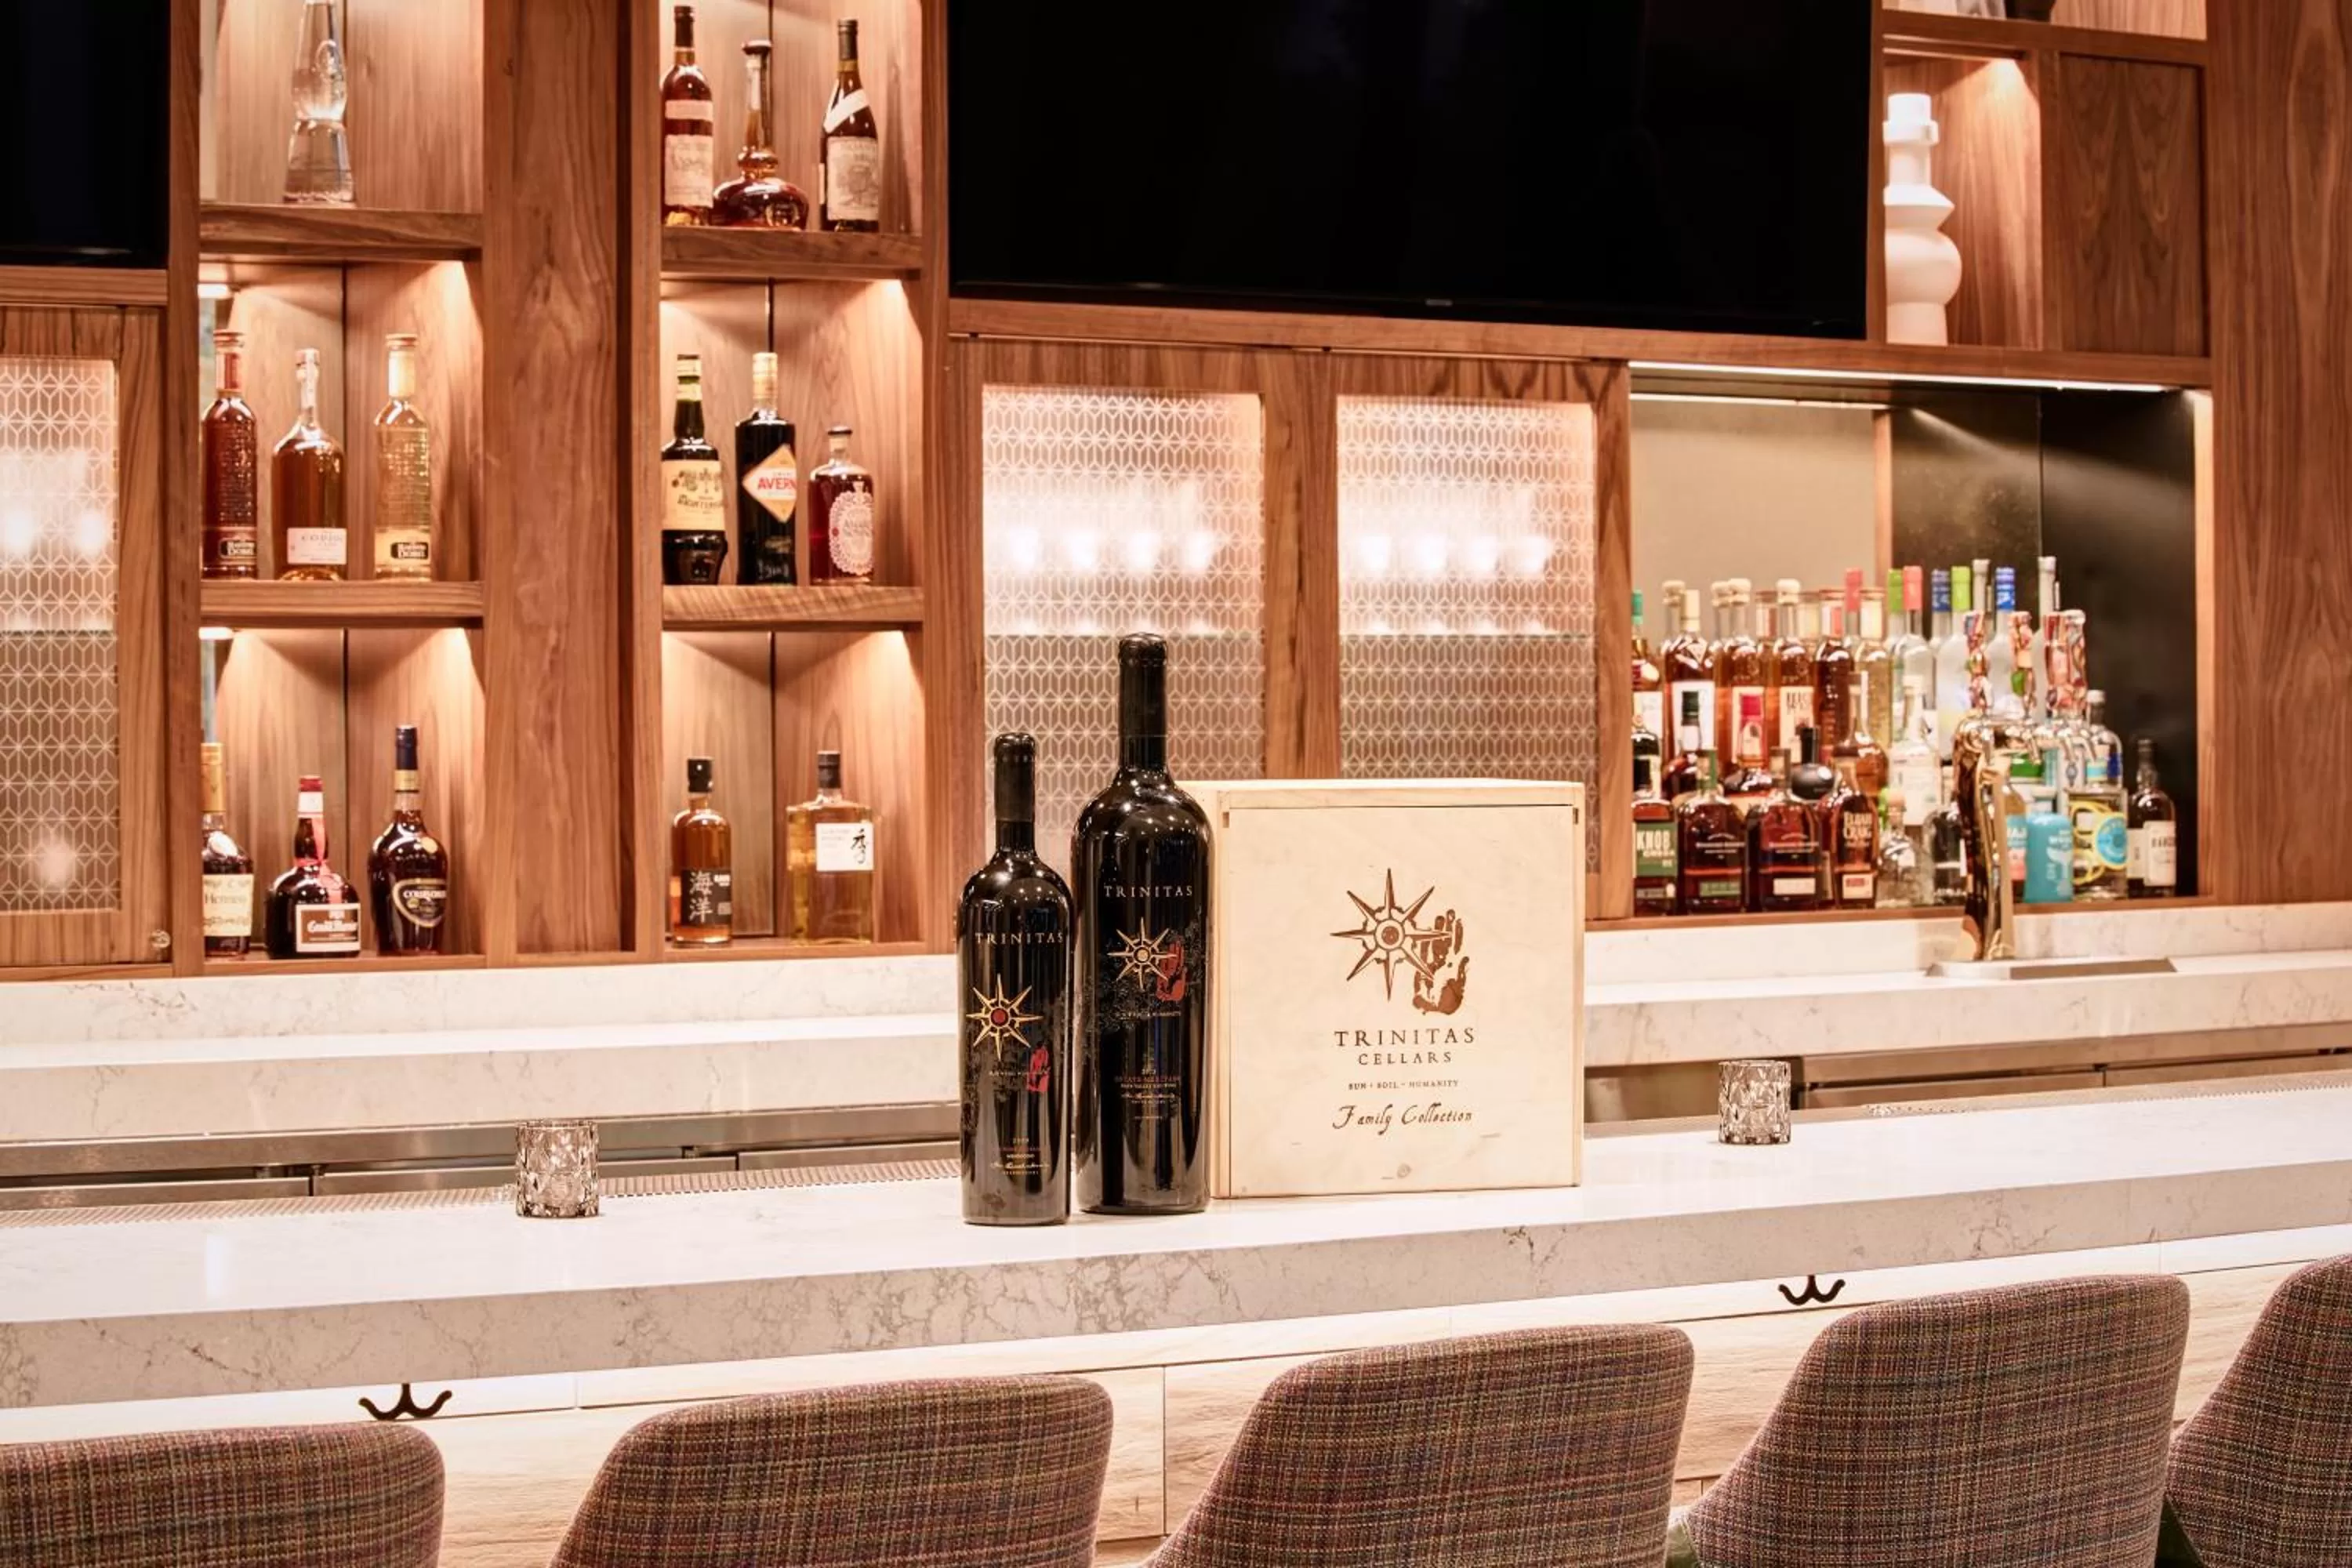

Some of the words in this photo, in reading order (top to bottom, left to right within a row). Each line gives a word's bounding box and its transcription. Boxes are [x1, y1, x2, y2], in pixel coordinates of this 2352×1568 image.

[1636, 830, 1671, 851] KNOB
[1104, 884, 1193, 898] TRINITAS
[975, 932, 1064, 945] TRINITAS
[1334, 1028, 1475, 1047] TRINITAS
[1358, 1051, 1452, 1065] CELLARS
[1333, 1104, 1393, 1135] Family
[1401, 1102, 1472, 1125] Collection
